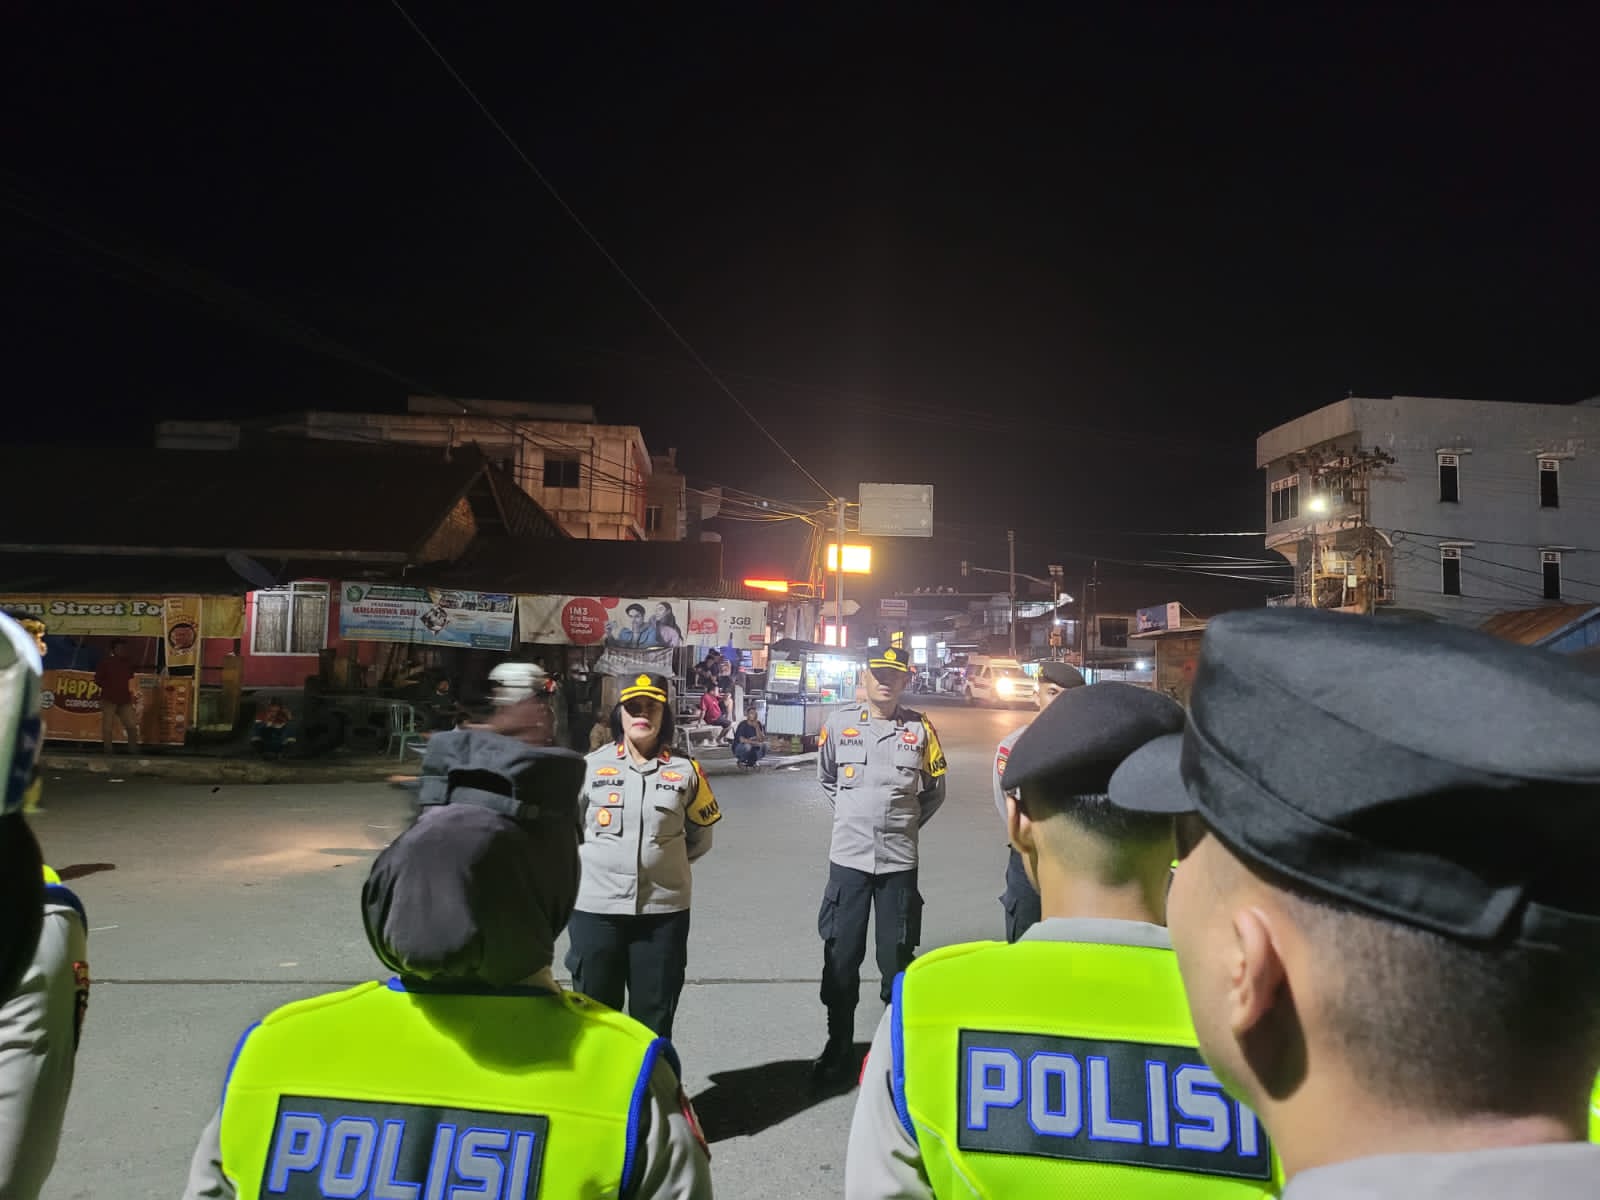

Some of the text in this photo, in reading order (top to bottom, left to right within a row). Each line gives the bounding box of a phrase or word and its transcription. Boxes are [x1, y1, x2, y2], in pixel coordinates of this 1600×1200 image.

[51, 601, 124, 615] Street
[570, 607, 588, 615] IM3
[730, 616, 751, 625] 3GB
[656, 783, 684, 792] POL
[967, 1046, 1259, 1157] POLISI
[268, 1111, 536, 1200] POLISI
